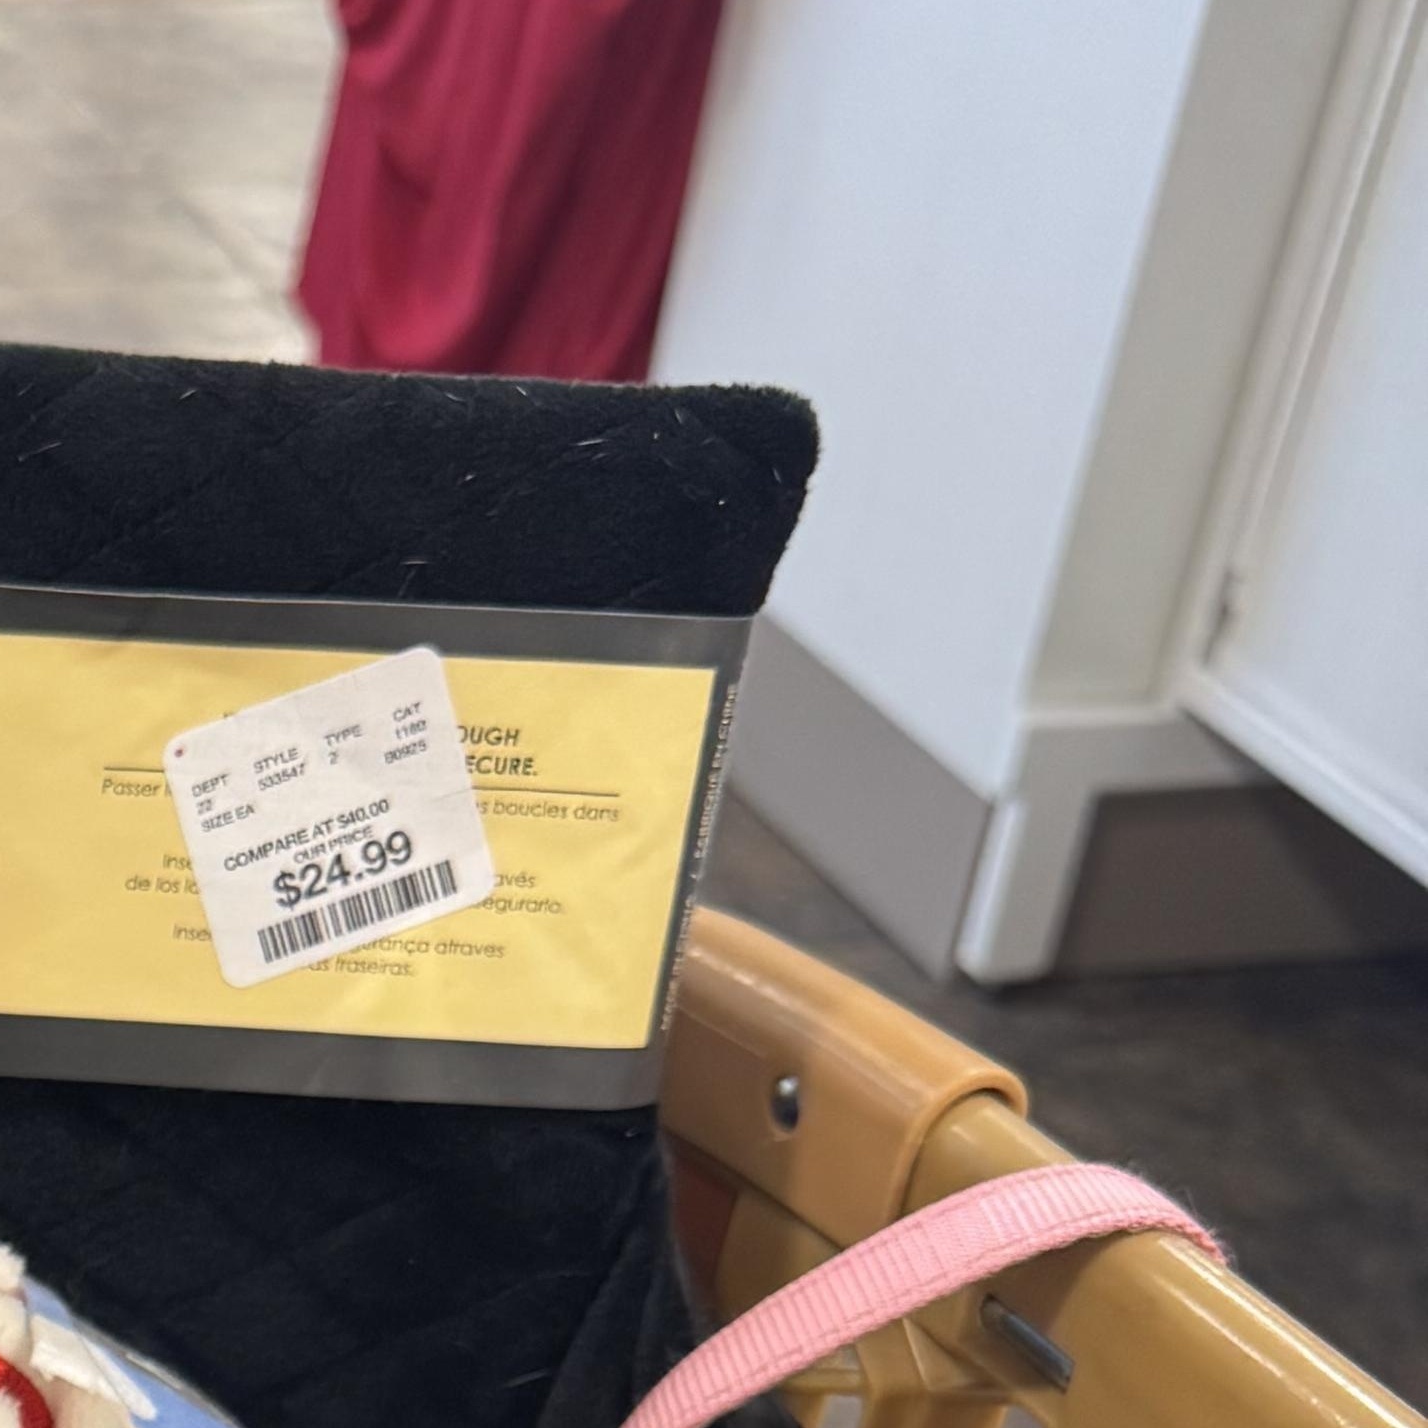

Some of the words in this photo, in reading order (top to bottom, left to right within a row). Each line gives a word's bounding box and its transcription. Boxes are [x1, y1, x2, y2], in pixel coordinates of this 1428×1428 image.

[457, 726, 521, 747] OUGH
[191, 772, 229, 797] DEPT
[253, 747, 300, 774] STYLE
[324, 724, 364, 747] TYPE
[392, 701, 423, 723] CAT
[465, 755, 538, 777] ECURE.
[101, 778, 161, 798] Passer
[200, 810, 235, 832] SIZE
[236, 803, 257, 820] EA
[493, 800, 569, 819] boucles
[574, 804, 620, 822] dans
[223, 829, 310, 872] COMPARE
[311, 817, 335, 839] AT
[336, 798, 391, 829] $40.00
[293, 842, 327, 864] OUR
[329, 825, 374, 848] PRICE
[162, 854, 193, 871] Inse
[273, 830, 414, 911] $24.99
[125, 875, 151, 892] de
[155, 877, 180, 894] los
